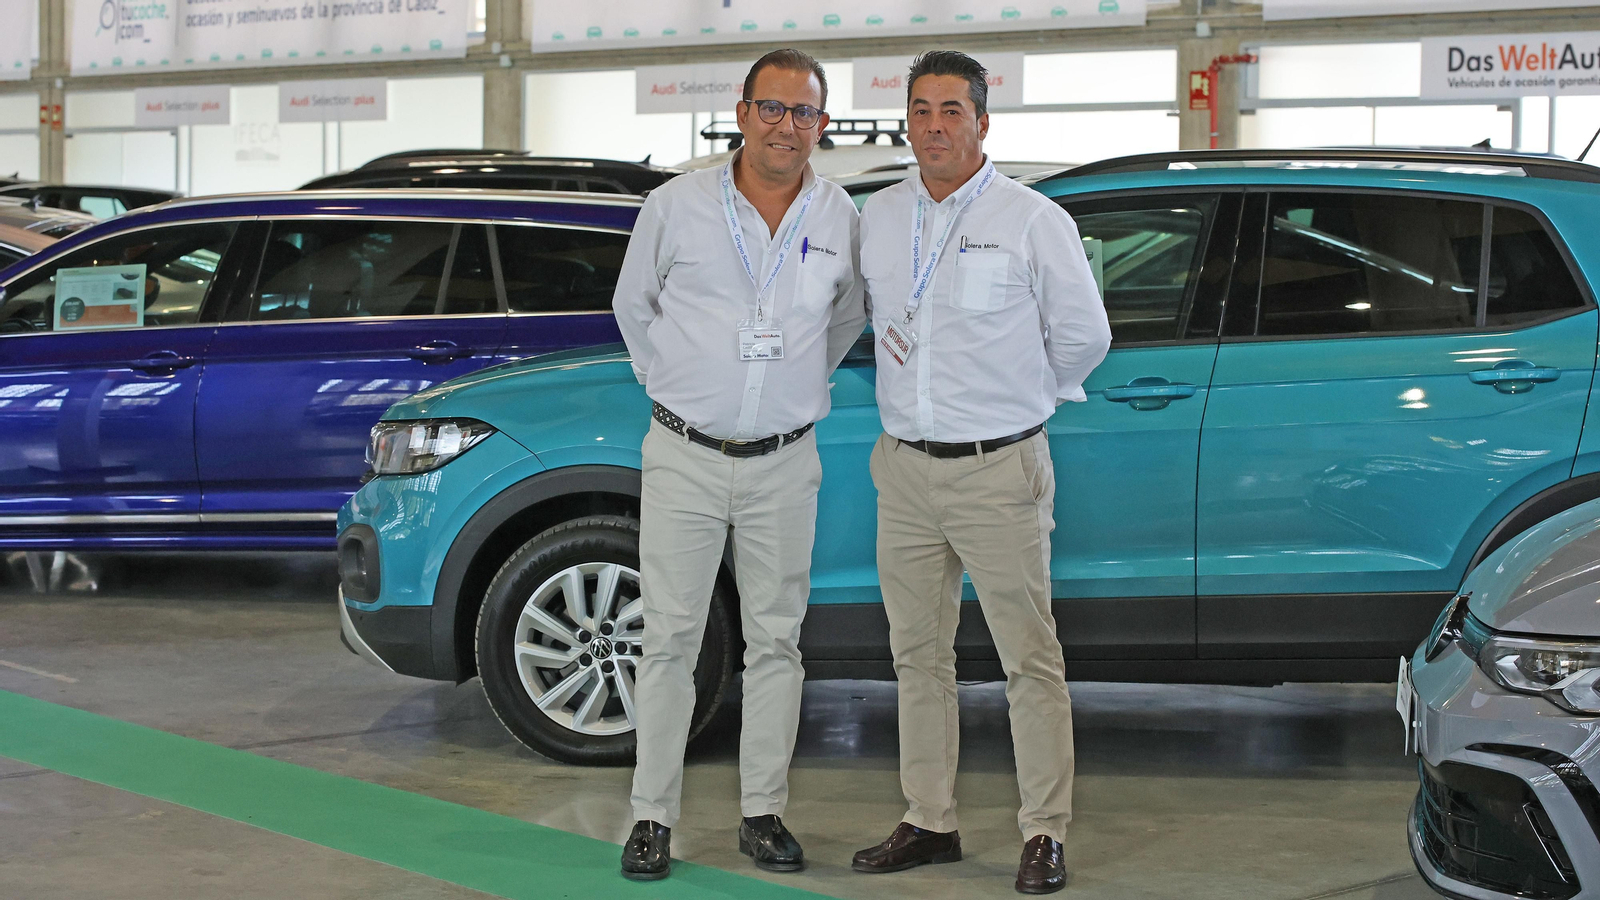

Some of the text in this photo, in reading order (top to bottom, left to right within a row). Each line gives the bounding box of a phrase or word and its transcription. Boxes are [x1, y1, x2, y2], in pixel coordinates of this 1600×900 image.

[226, 12, 233, 29] y
[236, 6, 297, 25] seminuevos
[301, 2, 314, 20] de
[317, 1, 329, 18] la
[332, 1, 384, 21] provincia
[388, 0, 401, 13] de
[1448, 46, 1493, 72] Das
[650, 83, 676, 95] Audi
[679, 81, 732, 95] Selection
[871, 75, 902, 89] Audi
[1498, 75, 1511, 88] de
[1514, 74, 1556, 88] ocasión
[234, 121, 282, 144] IFECA
[734, 233, 745, 255] Grupo
[807, 243, 838, 257] Solera Motor
[913, 279, 927, 299] Grupo
[885, 325, 910, 355] MOTORSUR
